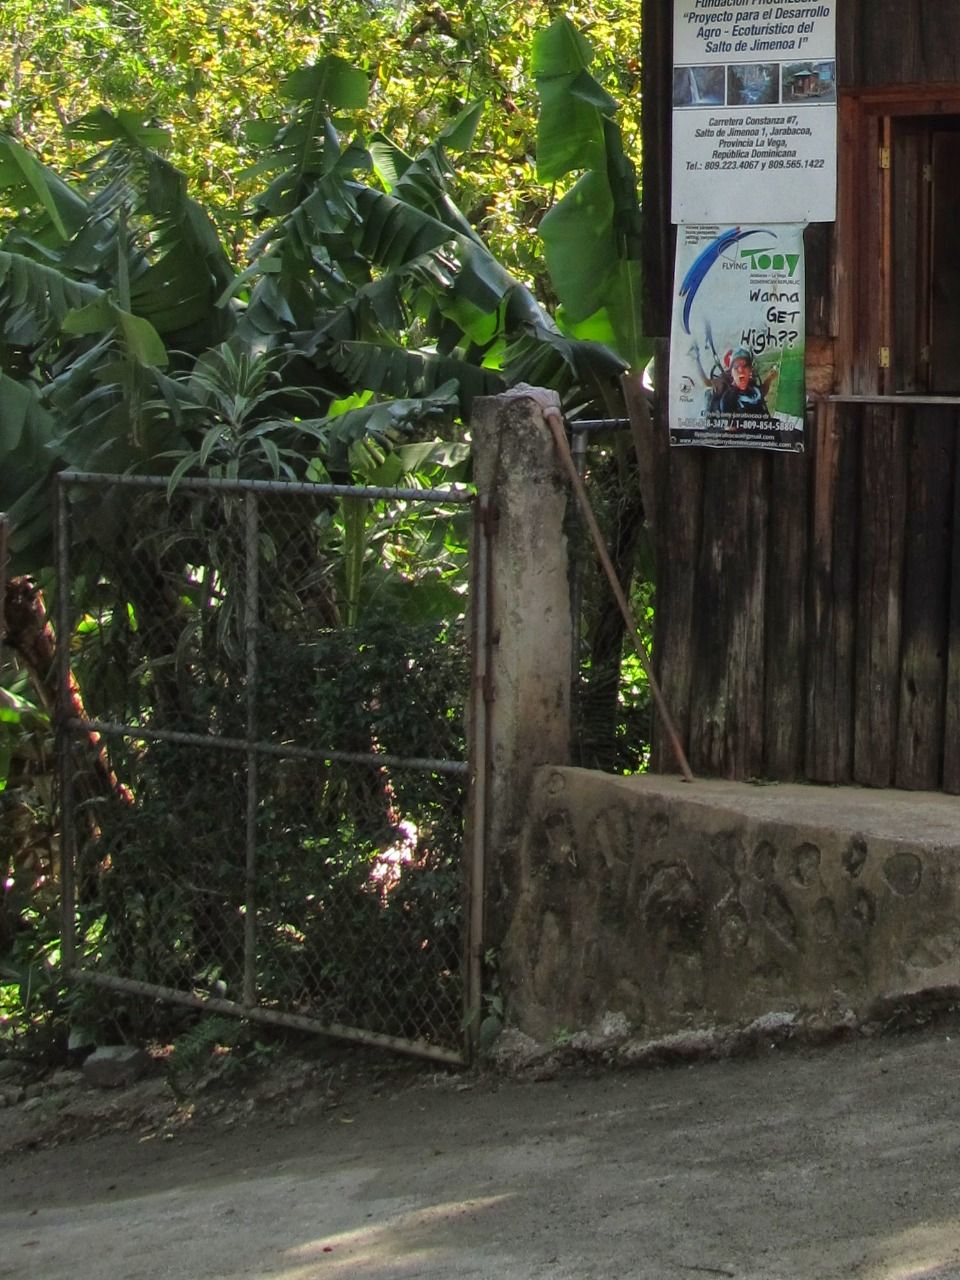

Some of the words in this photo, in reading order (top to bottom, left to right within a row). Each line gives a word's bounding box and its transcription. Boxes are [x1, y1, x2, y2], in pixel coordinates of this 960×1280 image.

[735, 11, 759, 23] para
[762, 8, 772, 19] el
[775, 6, 829, 19] Desarrollo
[696, 26, 721, 40] Agro
[732, 23, 794, 37] Ecoturístico
[797, 22, 814, 33] del
[705, 40, 732, 53] Salto
[735, 40, 747, 51] de
[750, 39, 795, 51] Jimenoa
[709, 117, 743, 126] Carretera
[746, 117, 785, 125] Constanza
[786, 116, 799, 125] #7,
[695, 128, 714, 137] Salto
[716, 128, 725, 137] de
[727, 128, 759, 137] Jimenoa
[762, 128, 768, 137] 1,
[770, 127, 812, 136] Jarabacoa,
[719, 138, 753, 147] Provincia
[756, 138, 765, 147] La
[767, 138, 787, 148] Vega,
[712, 150, 749, 160] República
[751, 149, 797, 158] Dominicana
[705, 161, 759, 170] 809.223.4067
[761, 162, 766, 170] y
[768, 160, 824, 169] 809.565.1422
[722, 262, 748, 270] FLYING
[741, 248, 800, 277] Tony
[749, 288, 800, 303] Wanna
[767, 307, 800, 324] GET
[740, 329, 799, 353] High??
